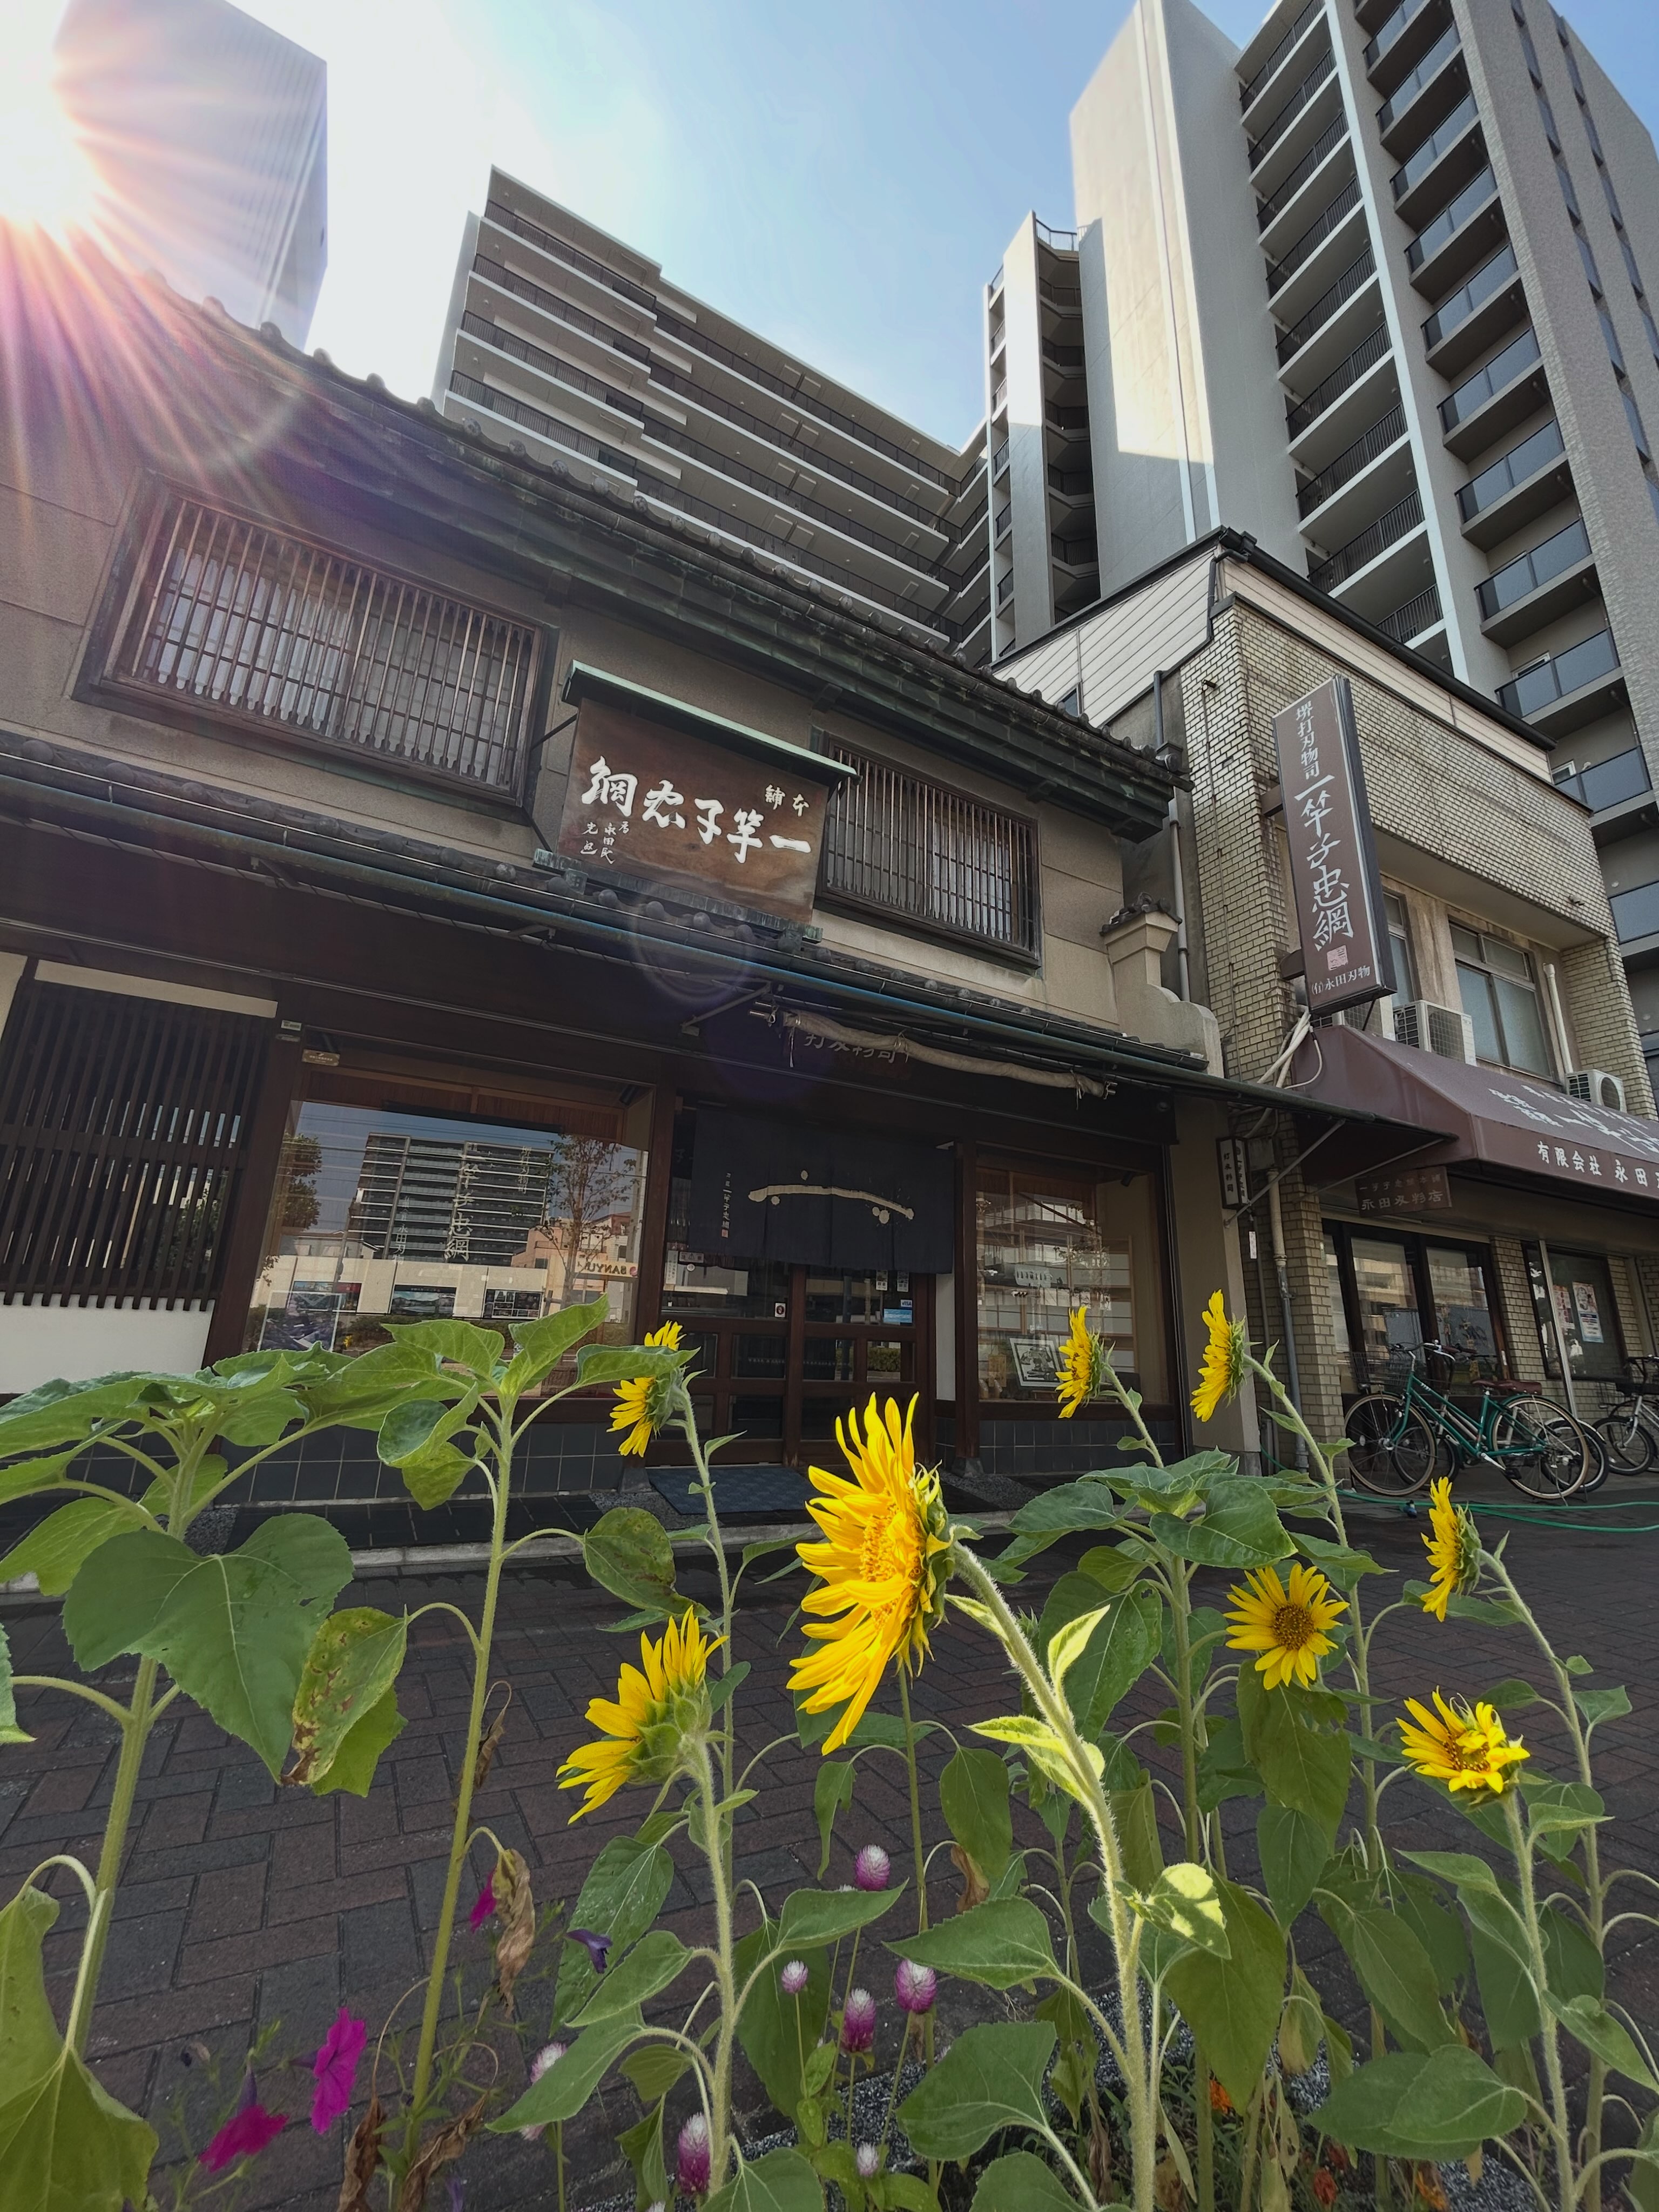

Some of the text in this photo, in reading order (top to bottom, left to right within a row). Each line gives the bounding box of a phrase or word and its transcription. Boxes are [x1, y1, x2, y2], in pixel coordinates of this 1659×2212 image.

[1296, 700, 1319, 779] 堺打刃物司
[1294, 774, 1354, 952] 一竿子忠綱
[1537, 1140, 1659, 1189] 有限会社 永田
